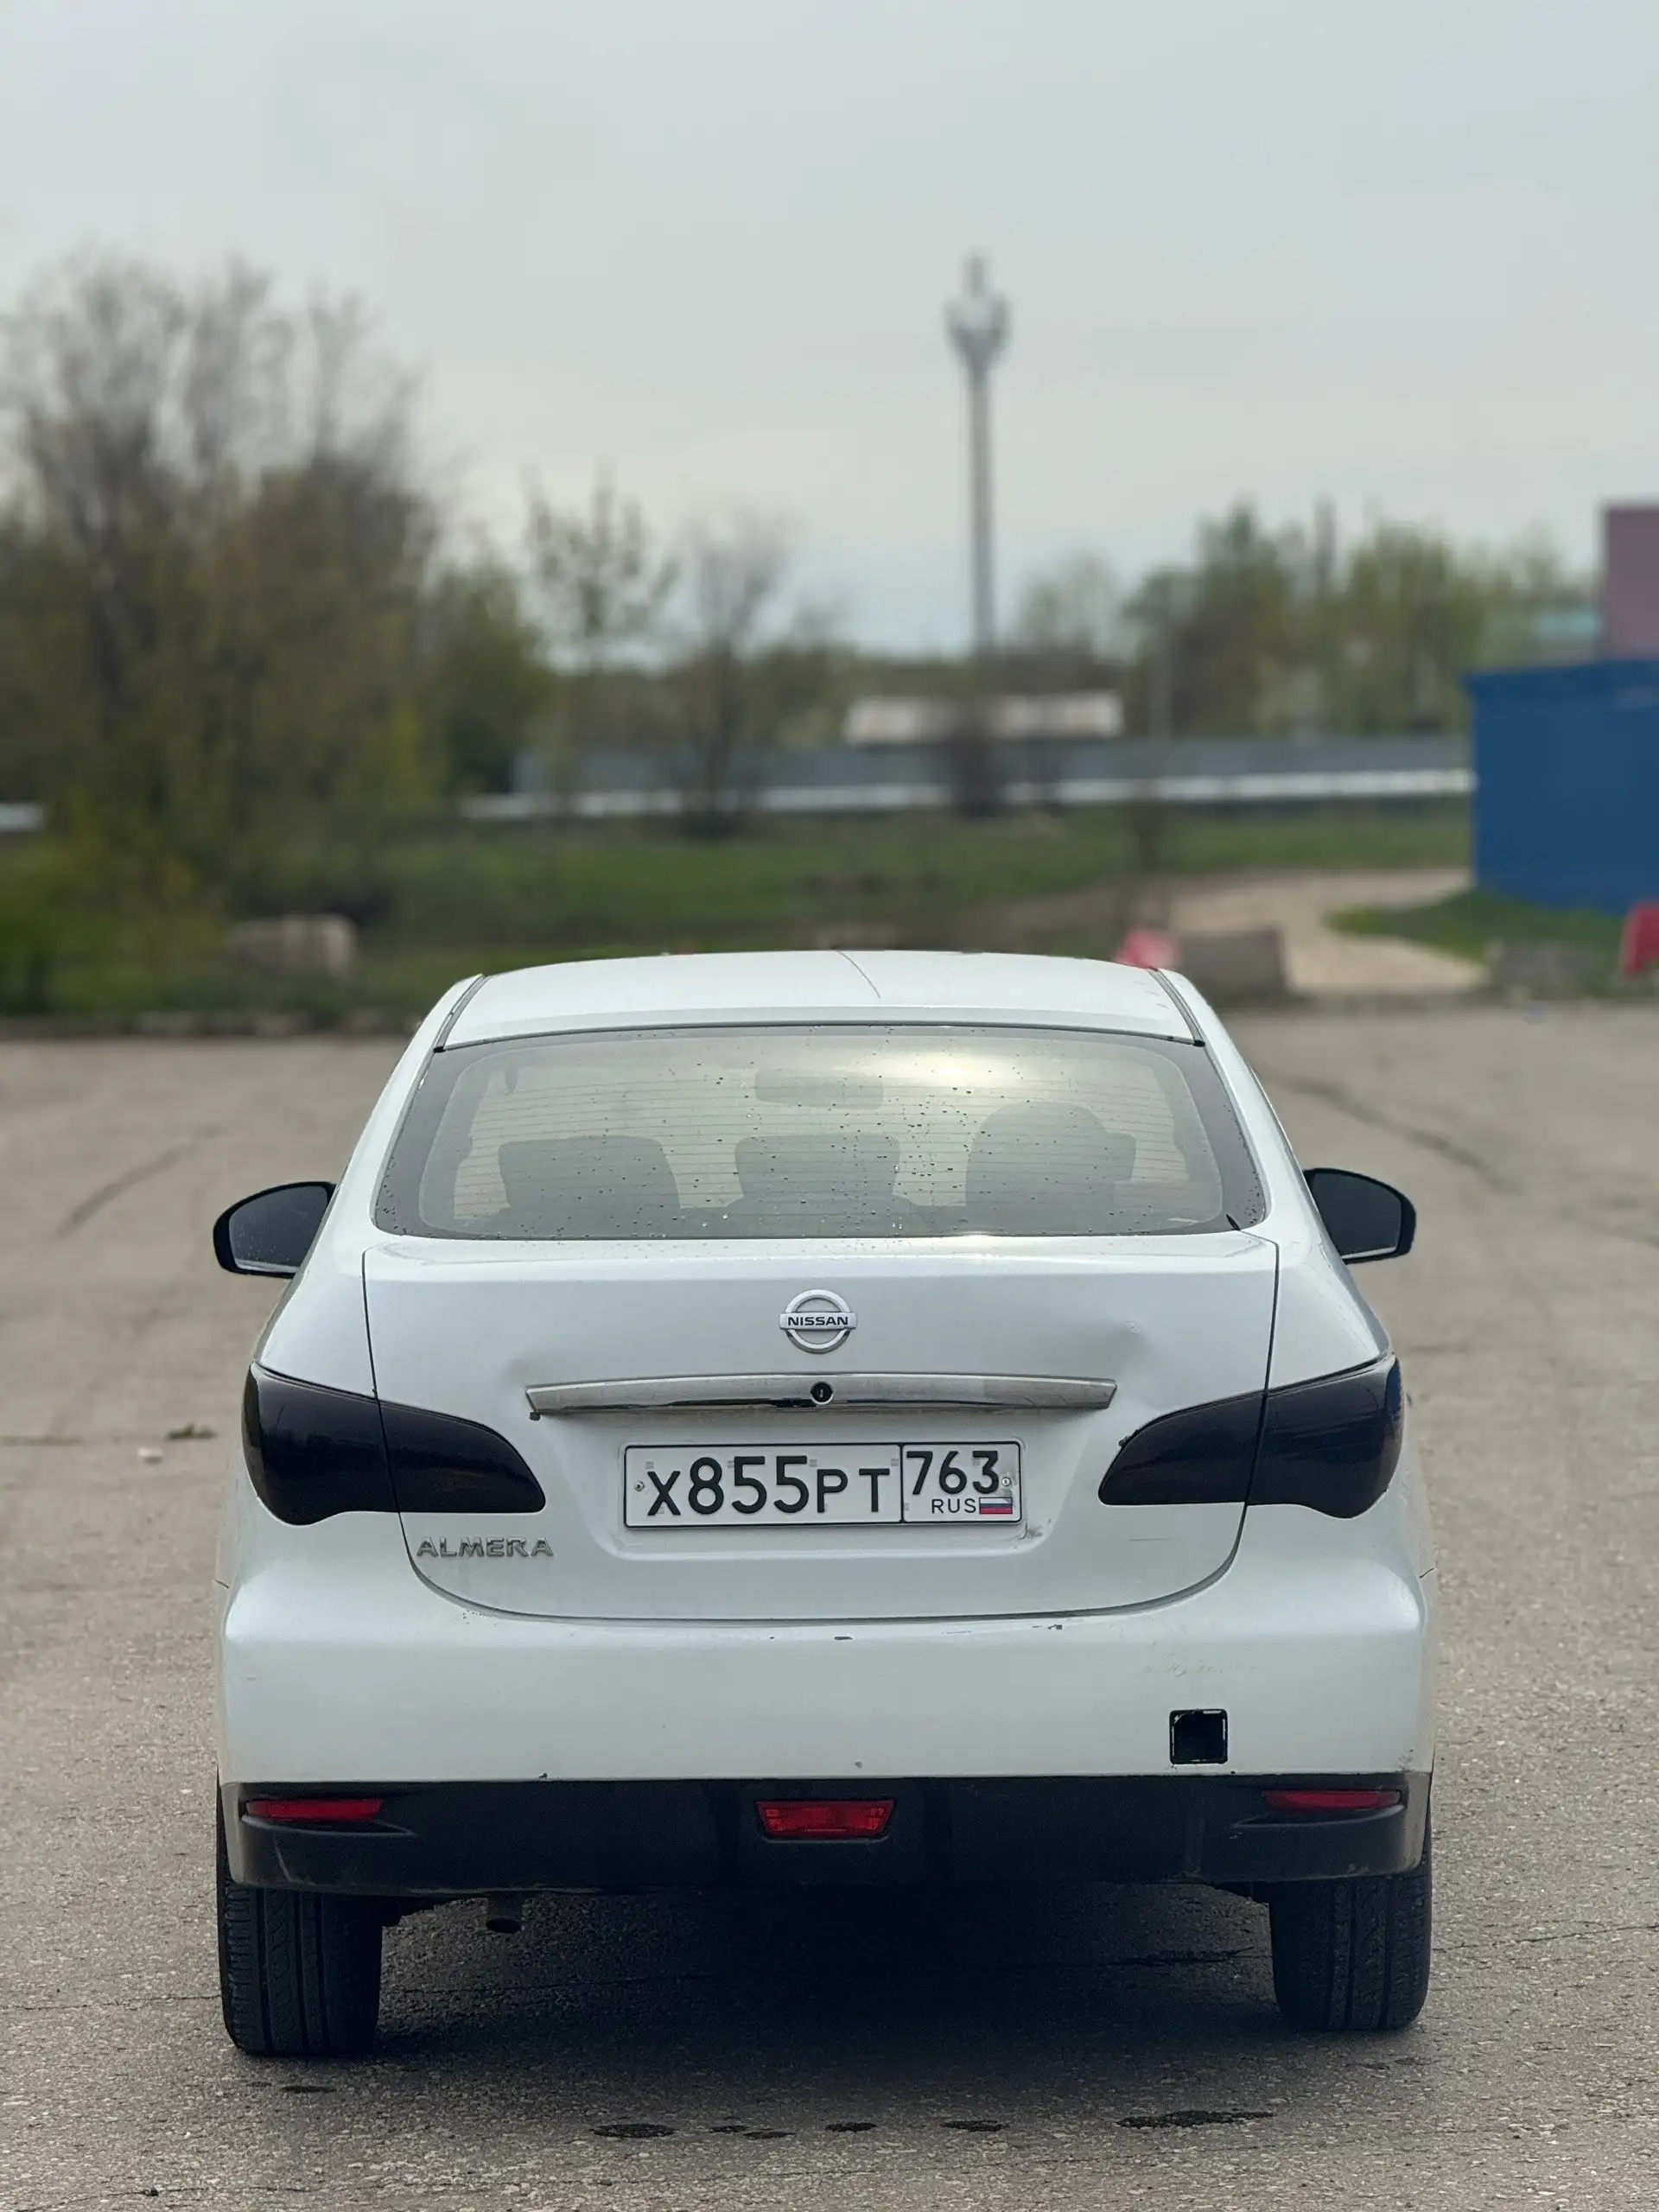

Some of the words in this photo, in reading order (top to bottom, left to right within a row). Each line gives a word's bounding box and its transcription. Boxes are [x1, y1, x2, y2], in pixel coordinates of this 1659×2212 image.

[787, 1316, 849, 1326] NISSAN
[906, 1450, 1000, 1496] 763
[931, 1497, 976, 1515] RUS
[416, 1537, 555, 1557] ALMERA
